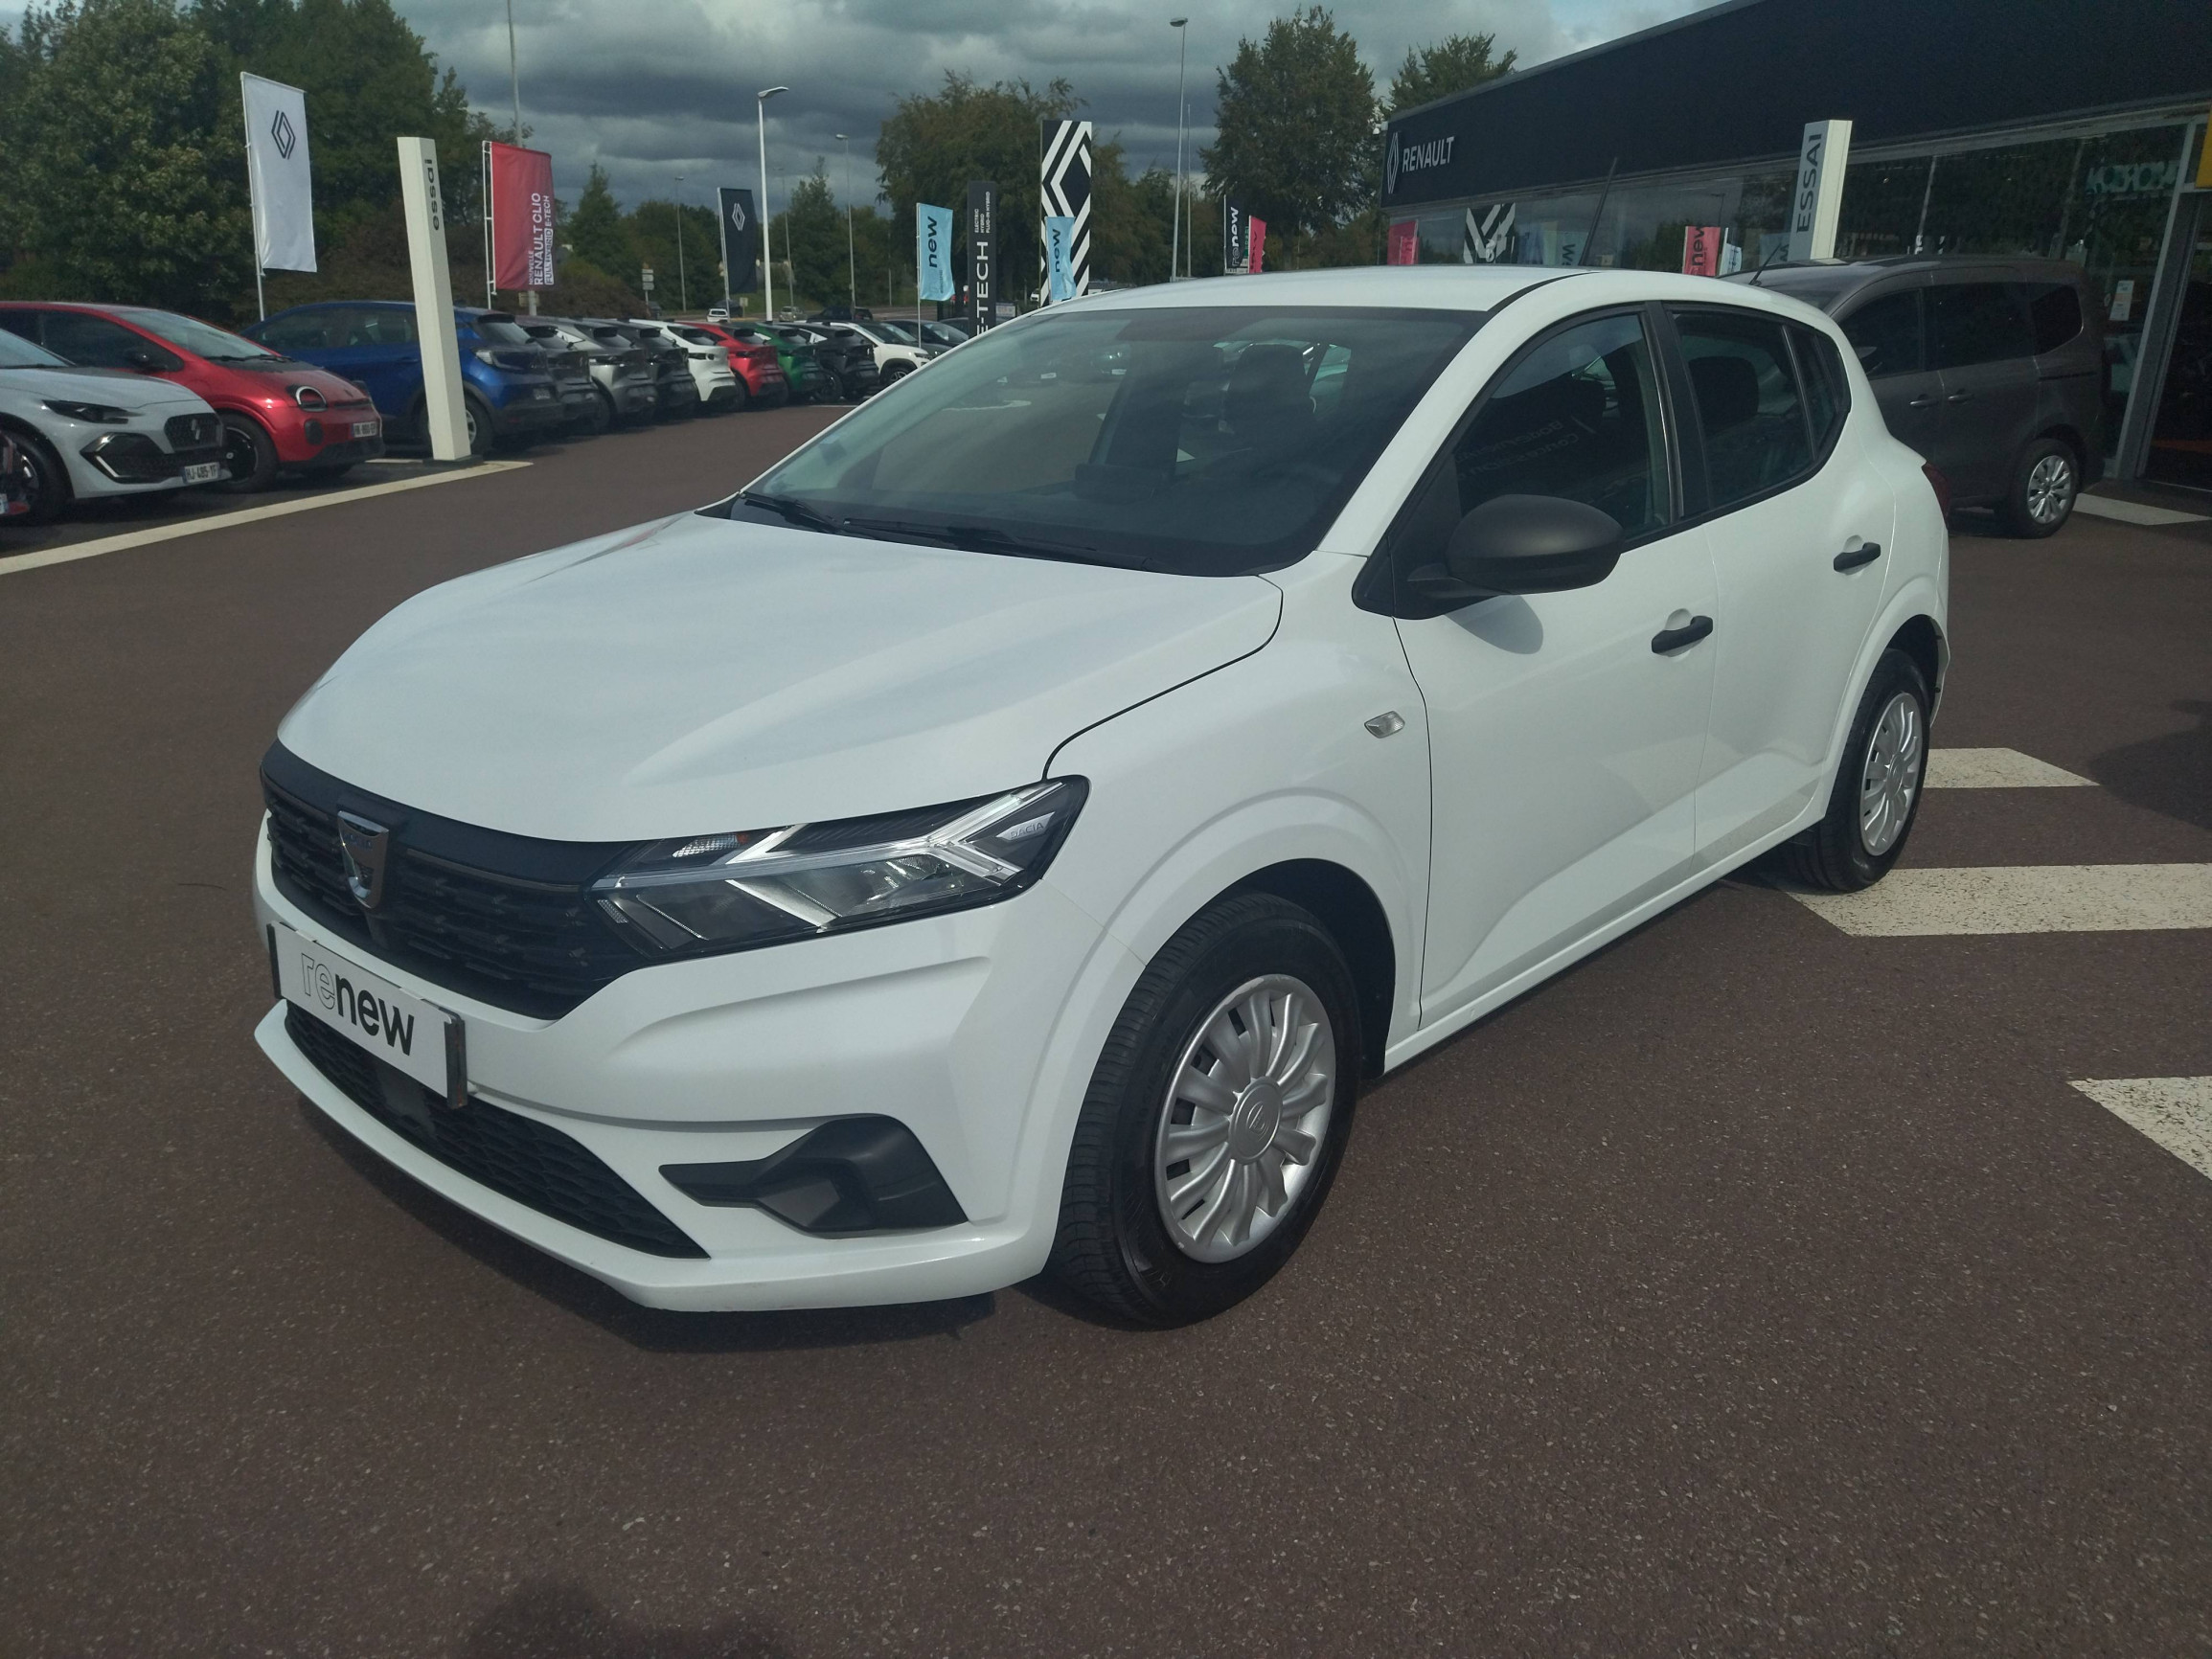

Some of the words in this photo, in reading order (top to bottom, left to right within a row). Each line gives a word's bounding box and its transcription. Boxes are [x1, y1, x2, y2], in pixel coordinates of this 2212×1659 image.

[1402, 136, 1455, 173] RENAULT
[424, 159, 440, 231] essai
[1796, 133, 1822, 233] ESSAI
[531, 193, 541, 223] CLIO
[543, 194, 552, 227] E-TECH
[533, 225, 543, 285] RENAULT
[544, 264, 554, 284] FULL
[976, 241, 989, 335] E-TECH
[1010, 822, 1044, 839] DACIA
[301, 952, 415, 1057] renew
